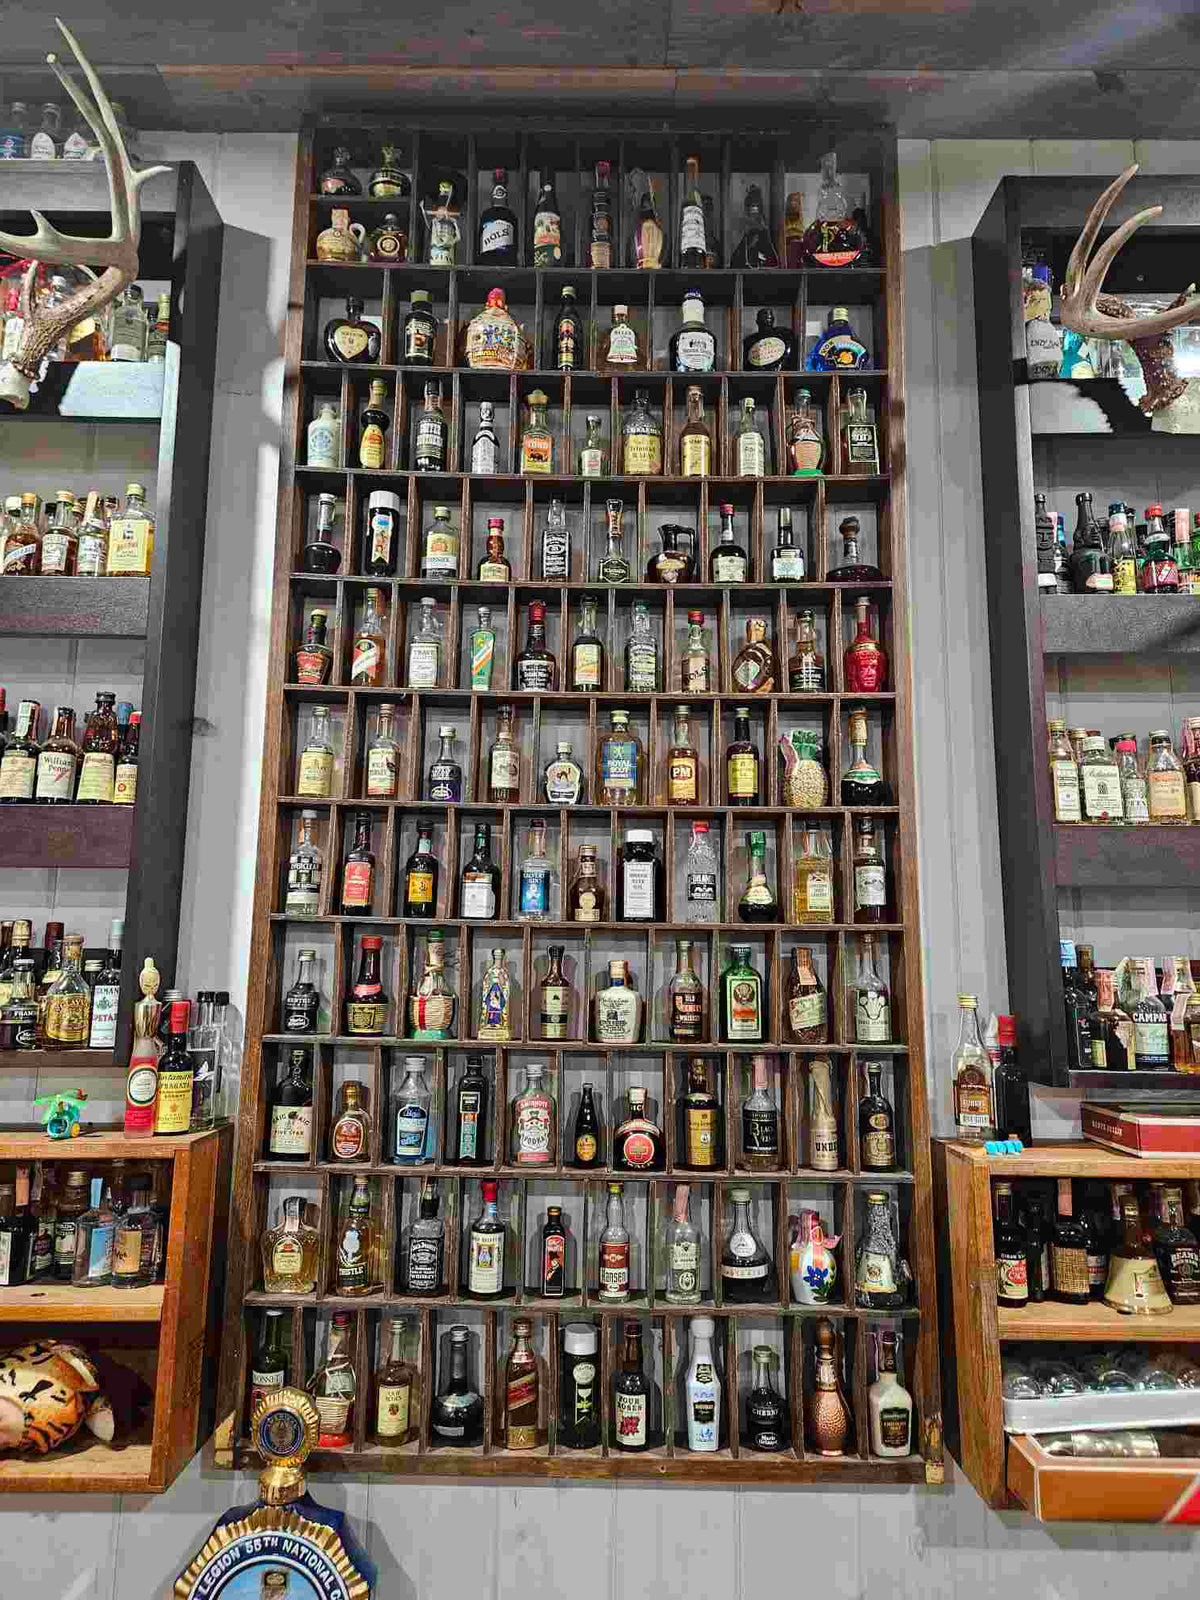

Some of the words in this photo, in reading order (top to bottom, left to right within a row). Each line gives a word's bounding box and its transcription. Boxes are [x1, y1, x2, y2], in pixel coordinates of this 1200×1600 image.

[484, 228, 511, 246] BOLS
[673, 767, 692, 778] PM
[602, 1268, 626, 1283] Hansen
[200, 1547, 242, 1595] LEGION
[283, 1539, 338, 1592] NATIONAL
